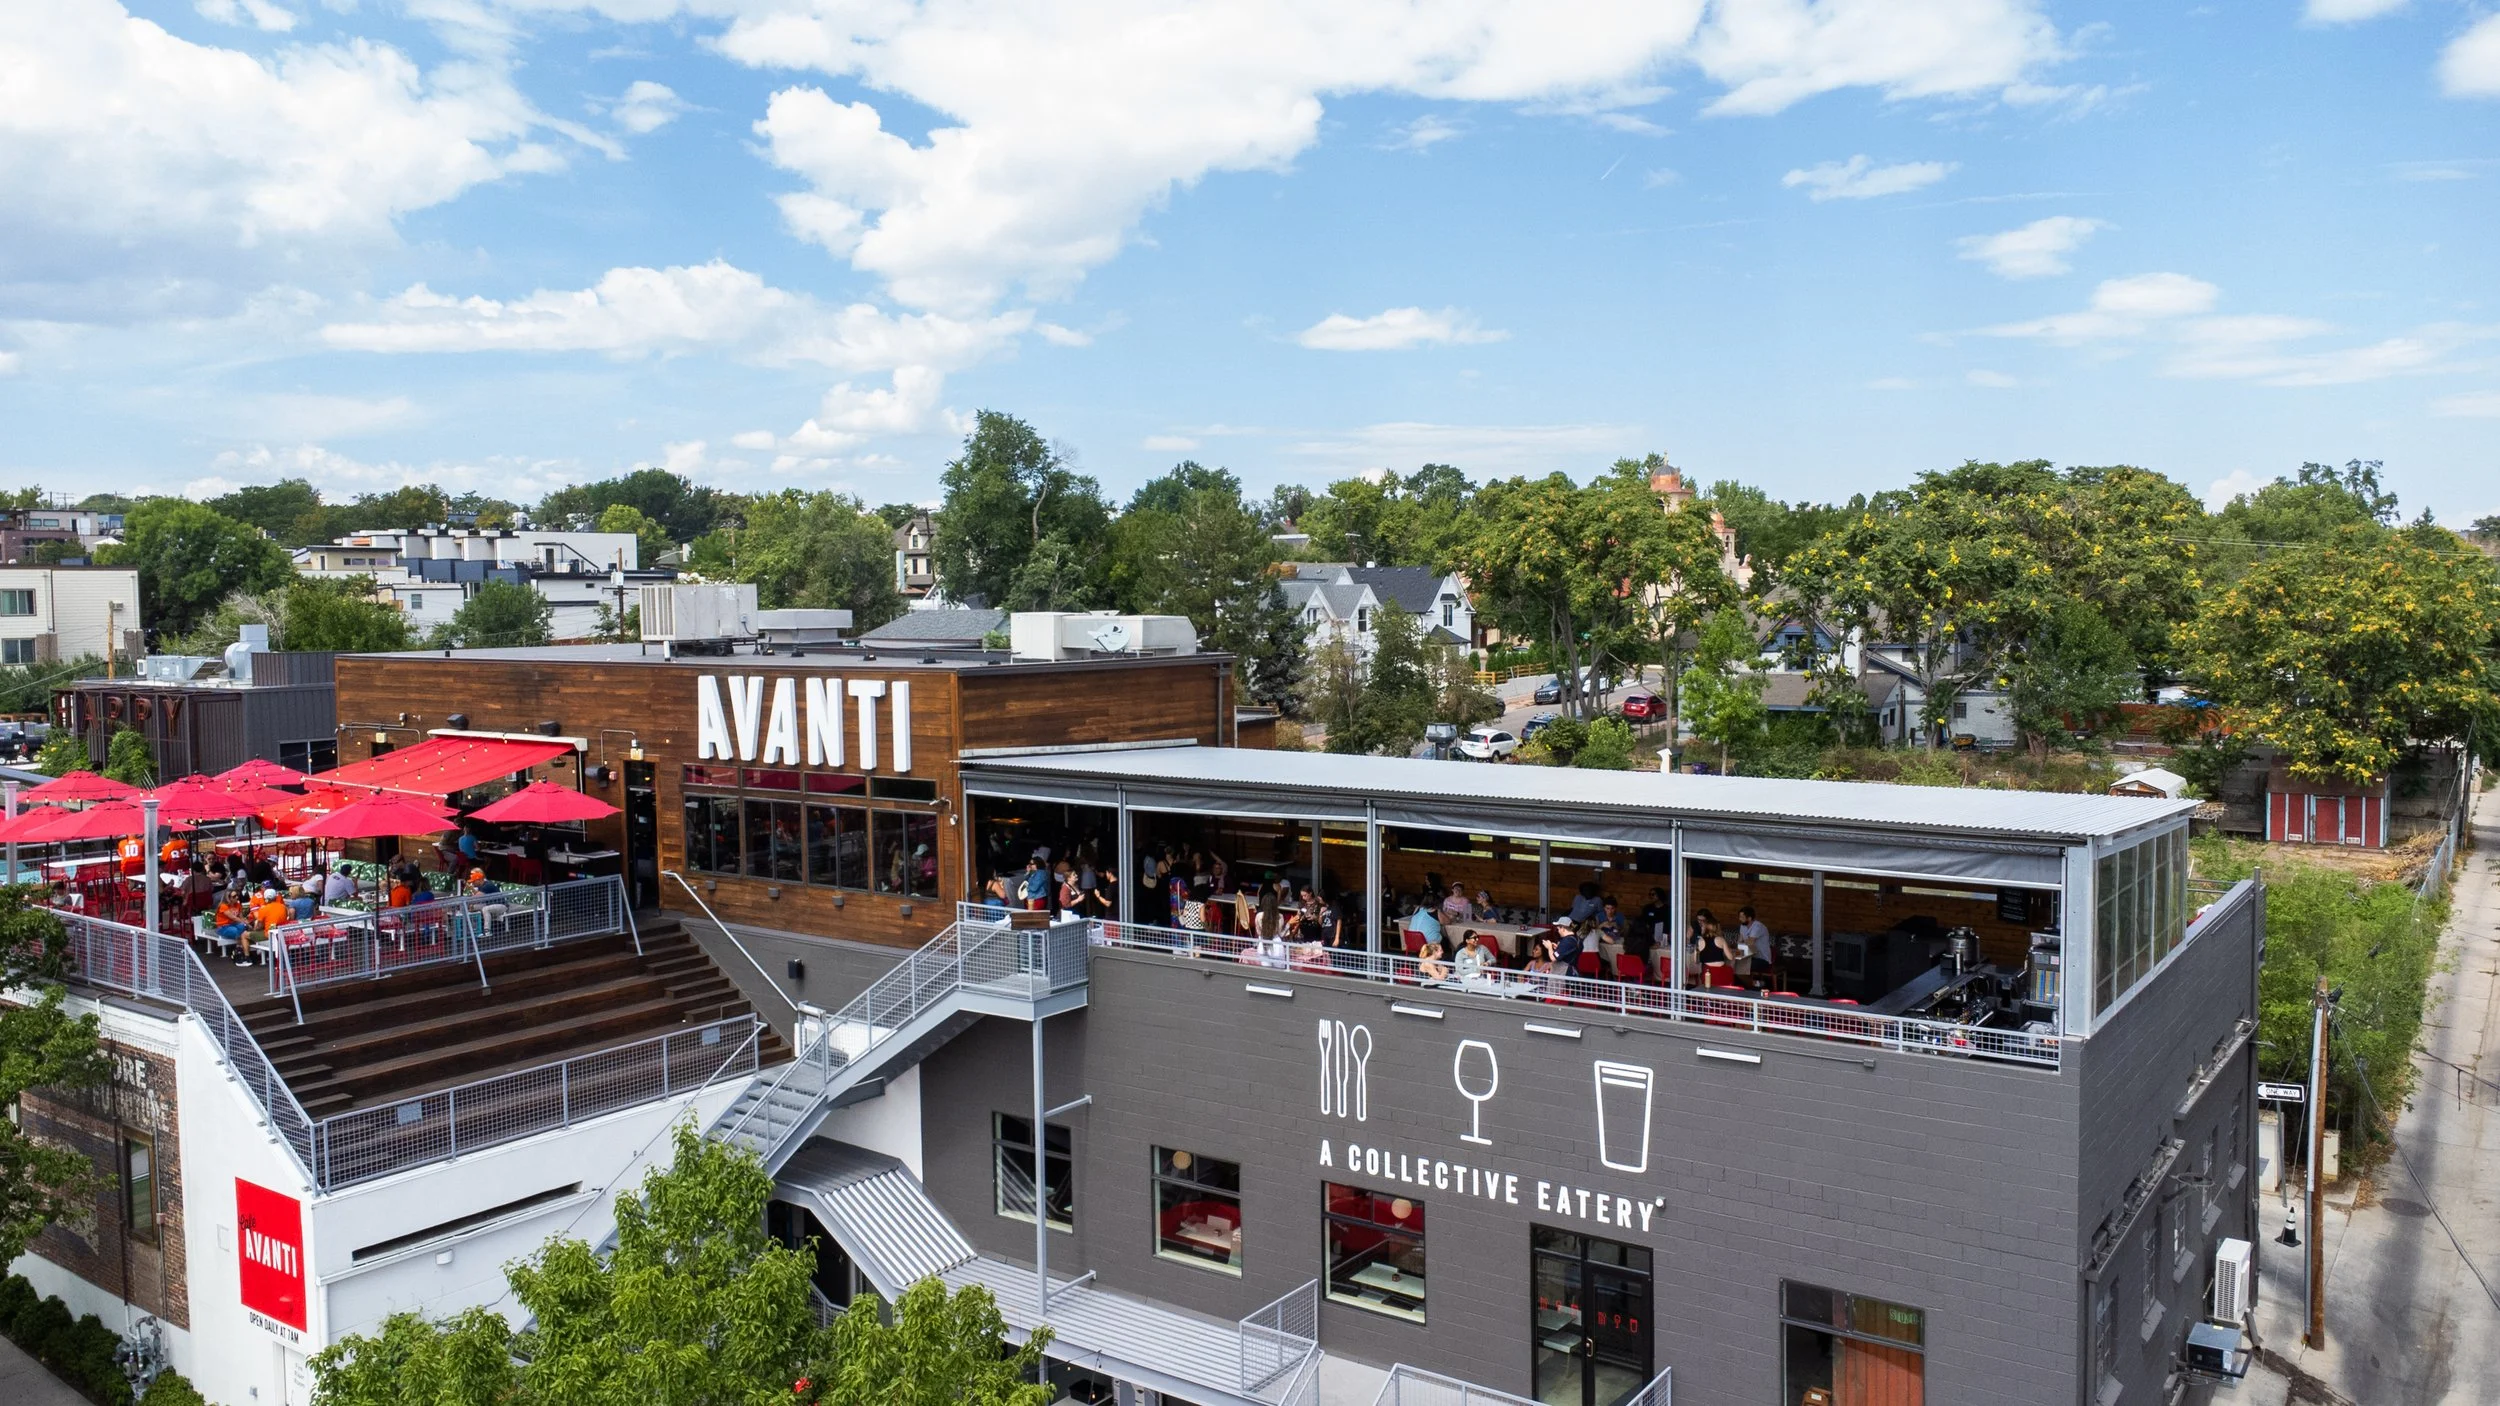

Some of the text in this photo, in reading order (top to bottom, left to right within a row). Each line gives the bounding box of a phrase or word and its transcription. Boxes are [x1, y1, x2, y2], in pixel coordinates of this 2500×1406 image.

[56, 692, 182, 738] HAPPY
[698, 675, 912, 773] AVANTI
[124, 843, 139, 858] 10
[2265, 1088, 2278, 1096] ONE
[1319, 1139, 1655, 1233] A COLLECTIVE EATERY
[245, 1228, 298, 1279] AVANTI
[249, 1311, 299, 1344] OPEN DAILY AT 7AM
